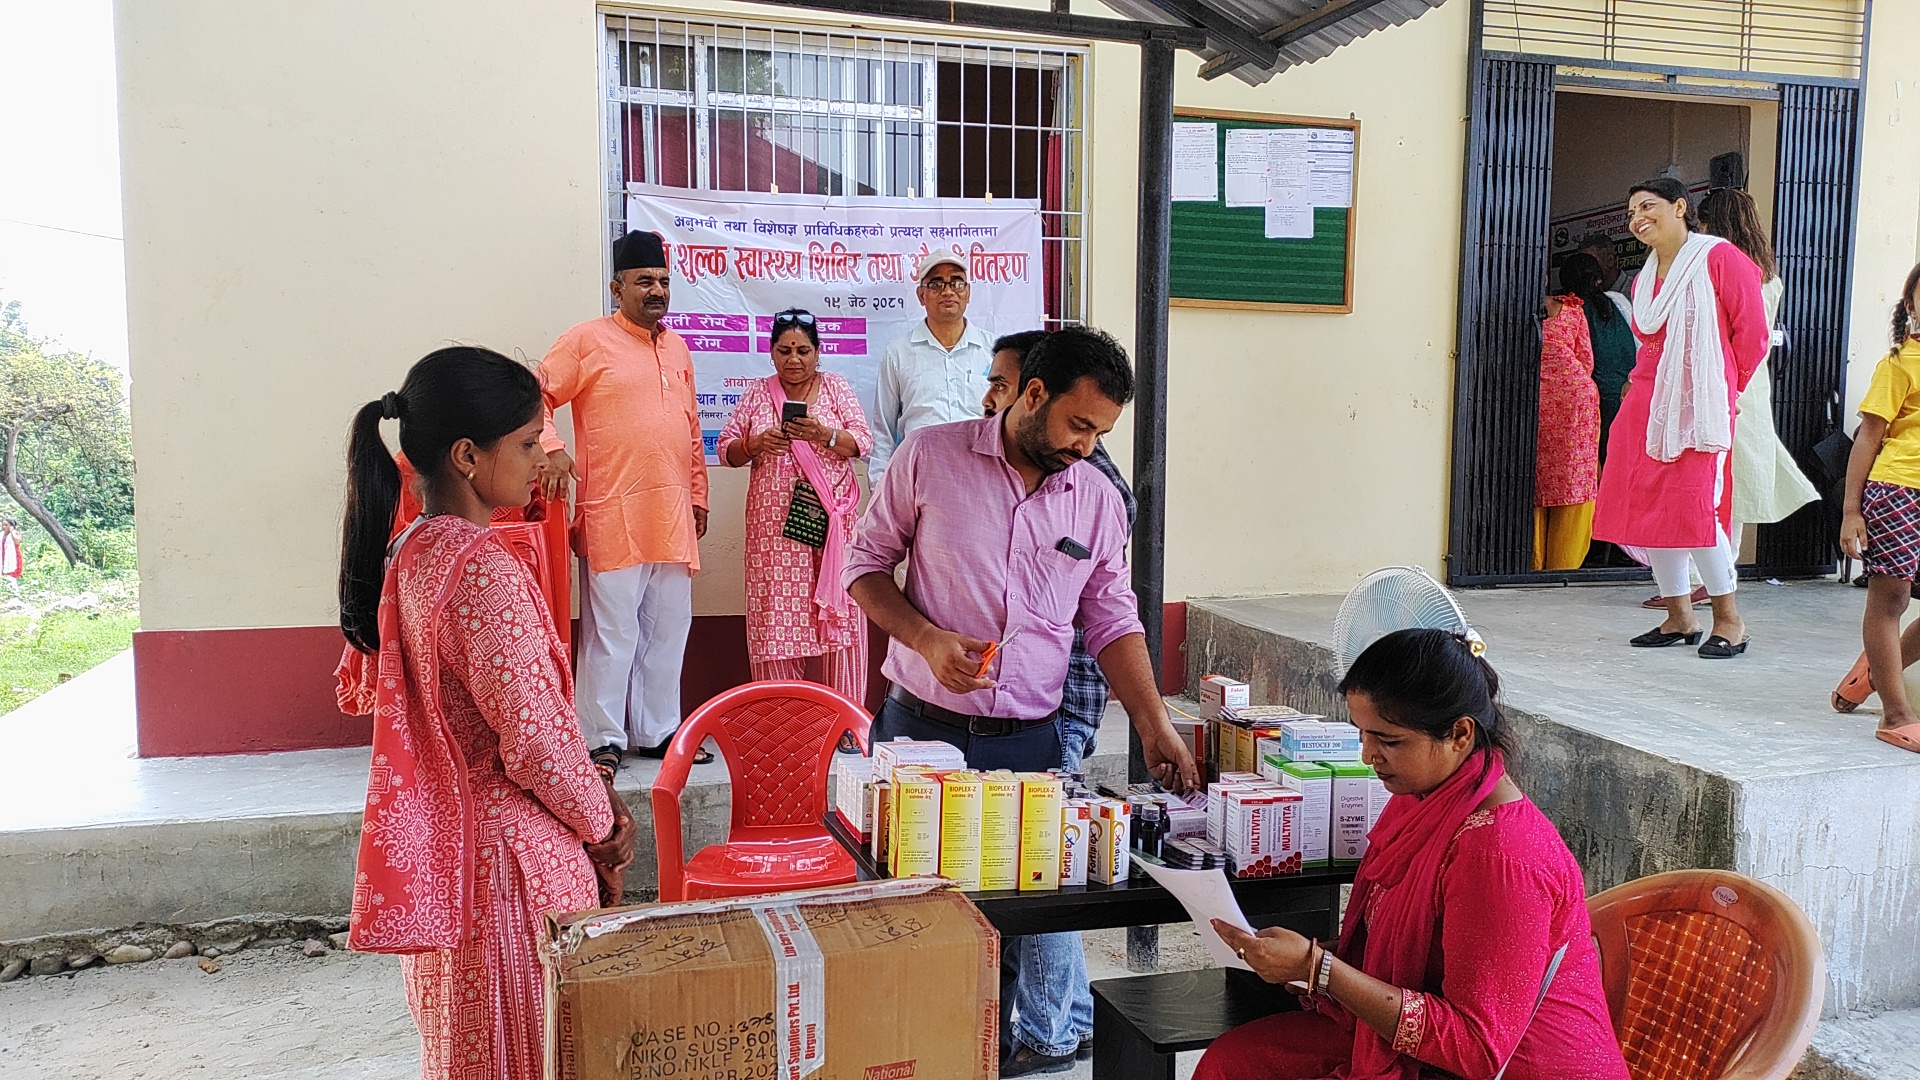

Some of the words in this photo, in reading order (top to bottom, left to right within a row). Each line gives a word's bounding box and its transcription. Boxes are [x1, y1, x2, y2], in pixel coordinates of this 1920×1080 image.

[674, 215, 718, 232] अनुभवी
[724, 220, 747, 233] तथा
[754, 219, 798, 236] विशेषज्ञ
[889, 226, 925, 239] प्रत्यक्ष
[929, 222, 999, 240] सहभागितामा
[733, 246, 803, 282] स्वास्थ्य
[867, 252, 903, 283] तथा
[969, 241, 1029, 284] वितरण
[824, 296, 841, 309] १९
[848, 294, 868, 309] जेठ
[872, 297, 905, 310] २०८१
[660, 313, 692, 329] सुती
[697, 314, 728, 329] रोग
[692, 335, 723, 350] रोग
[949, 785, 977, 793] BIOPLEX-Z
[1028, 786, 1056, 794] BIOPLEX-Z
[1251, 808, 1261, 855] MULTIVITA
[1281, 805, 1291, 851] MULTIVITA
[1061, 835, 1076, 879] Fortiplex
[1112, 833, 1122, 877] Fortiplex
[787, 981, 800, 1000] Ltd.
[787, 1000, 800, 1018] Pvt.
[631, 1026, 686, 1047] CASE
[787, 1018, 800, 1065] Suppliers
[804, 1023, 817, 1060] Birgunj
[982, 998, 995, 1072] Healthcare
[631, 1045, 678, 1064] NIKO
[863, 1061, 916, 1080] National
